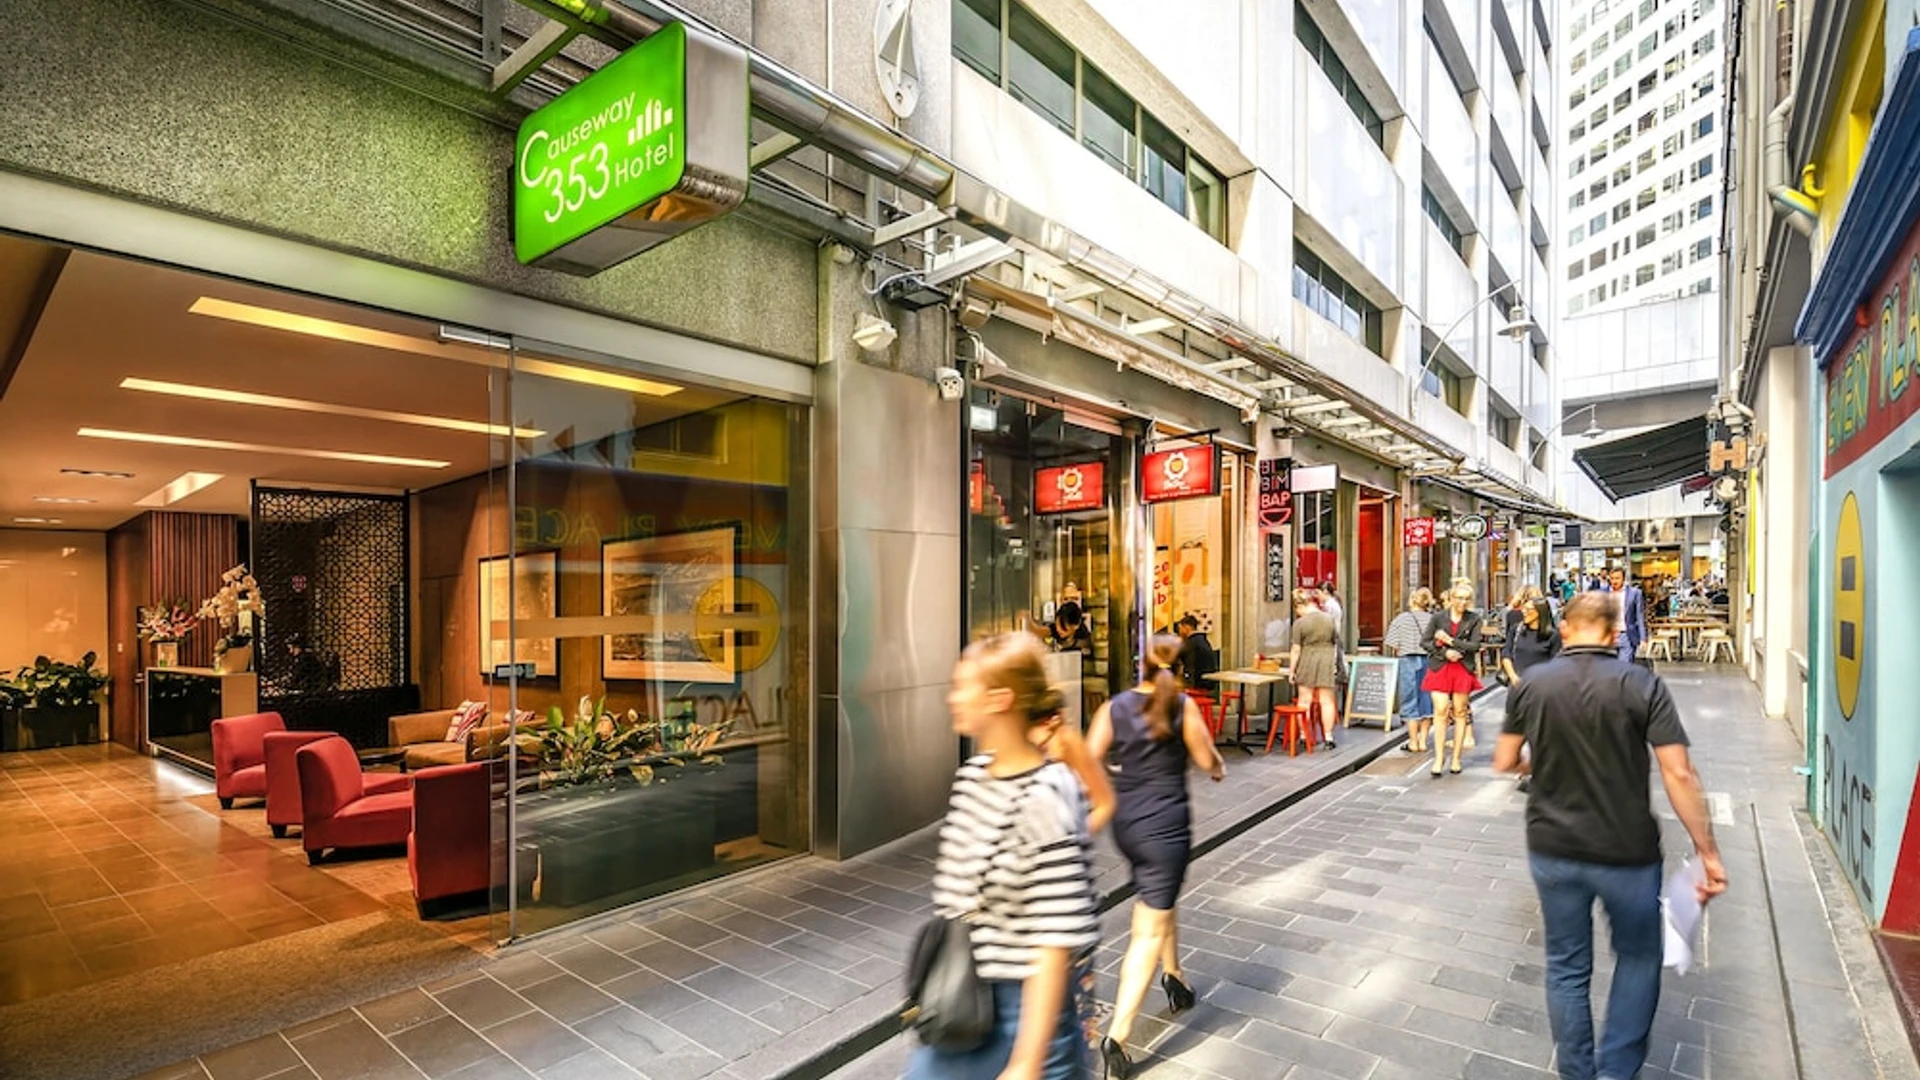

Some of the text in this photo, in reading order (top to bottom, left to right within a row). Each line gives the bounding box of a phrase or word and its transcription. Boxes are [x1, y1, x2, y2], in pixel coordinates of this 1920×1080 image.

[520, 92, 636, 188] Causeway
[543, 133, 675, 224] 353 Hotel
[1261, 491, 1291, 508] BAP
[1823, 733, 1872, 903] PLACE
